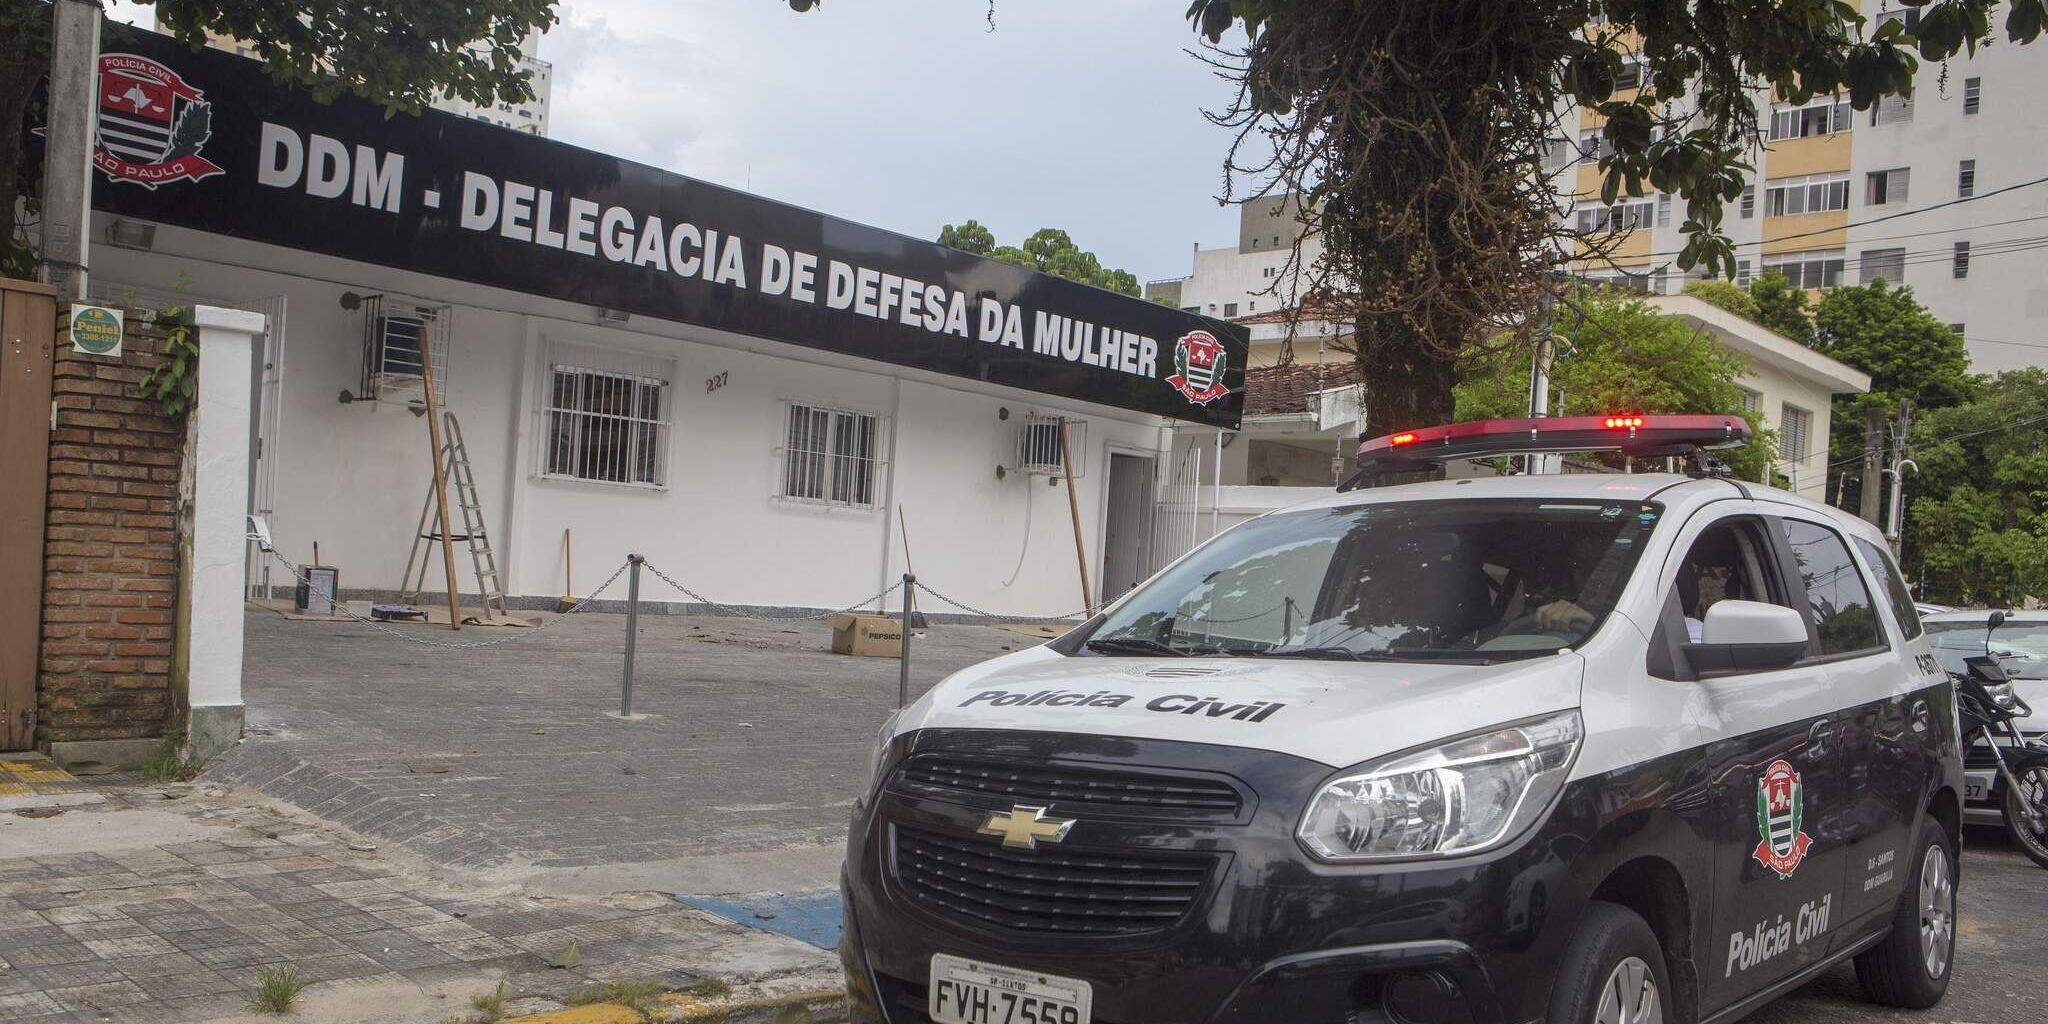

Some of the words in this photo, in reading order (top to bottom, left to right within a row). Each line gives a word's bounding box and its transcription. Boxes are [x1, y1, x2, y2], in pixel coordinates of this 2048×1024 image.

[148, 66, 174, 83] CIVIL
[125, 162, 185, 178] PAULO
[258, 121, 405, 214] DDM
[424, 189, 440, 208] -
[461, 170, 747, 289] DELEGACIA
[760, 243, 818, 303] DE
[827, 260, 969, 338] DEFESA
[978, 297, 1024, 350] DA
[1033, 310, 1159, 379] MULHER
[705, 369, 729, 394] 227
[869, 632, 902, 641] PEPSICO
[956, 689, 1135, 708] Polícia
[1145, 694, 1286, 723] Civil
[1725, 914, 1791, 978] Polícia
[1795, 892, 1832, 945] Civil
